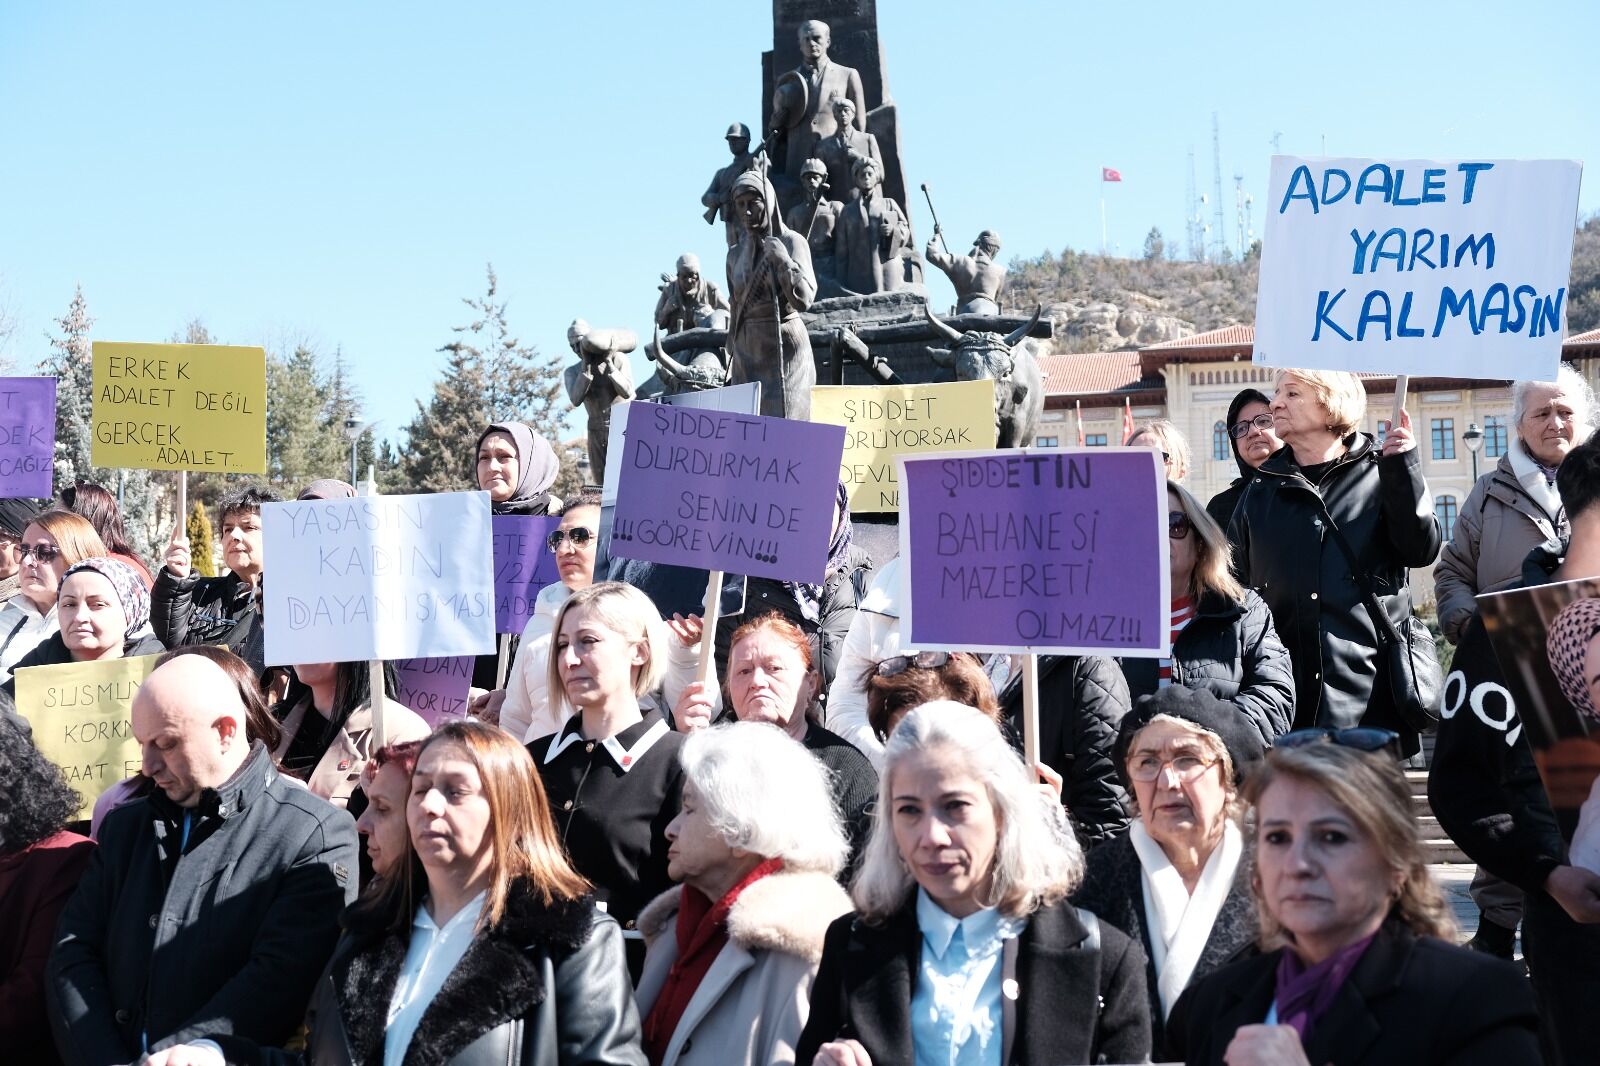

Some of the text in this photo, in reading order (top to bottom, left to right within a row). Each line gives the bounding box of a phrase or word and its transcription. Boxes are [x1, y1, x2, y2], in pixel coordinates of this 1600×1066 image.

[1279, 162, 1495, 215] ADALET
[1349, 227, 1496, 275] YARIM
[1311, 282, 1566, 342] KALMASIN
[109, 356, 190, 380] ERKEK
[100, 384, 253, 414] ADALET DEĞİL
[843, 397, 937, 422] ŞİDDET
[96, 421, 182, 445] GERÇEK
[654, 407, 767, 442] ŞİDDETİ
[634, 439, 802, 485] DURDURMAK
[941, 453, 1091, 498] ŞİDDETİN
[282, 502, 423, 538] YAŞASIN
[678, 490, 803, 533] SENİN DE
[319, 545, 442, 578] KADIN
[941, 558, 1094, 602] MAZERETİ
[1016, 609, 1141, 643] OLMAZ!!!
